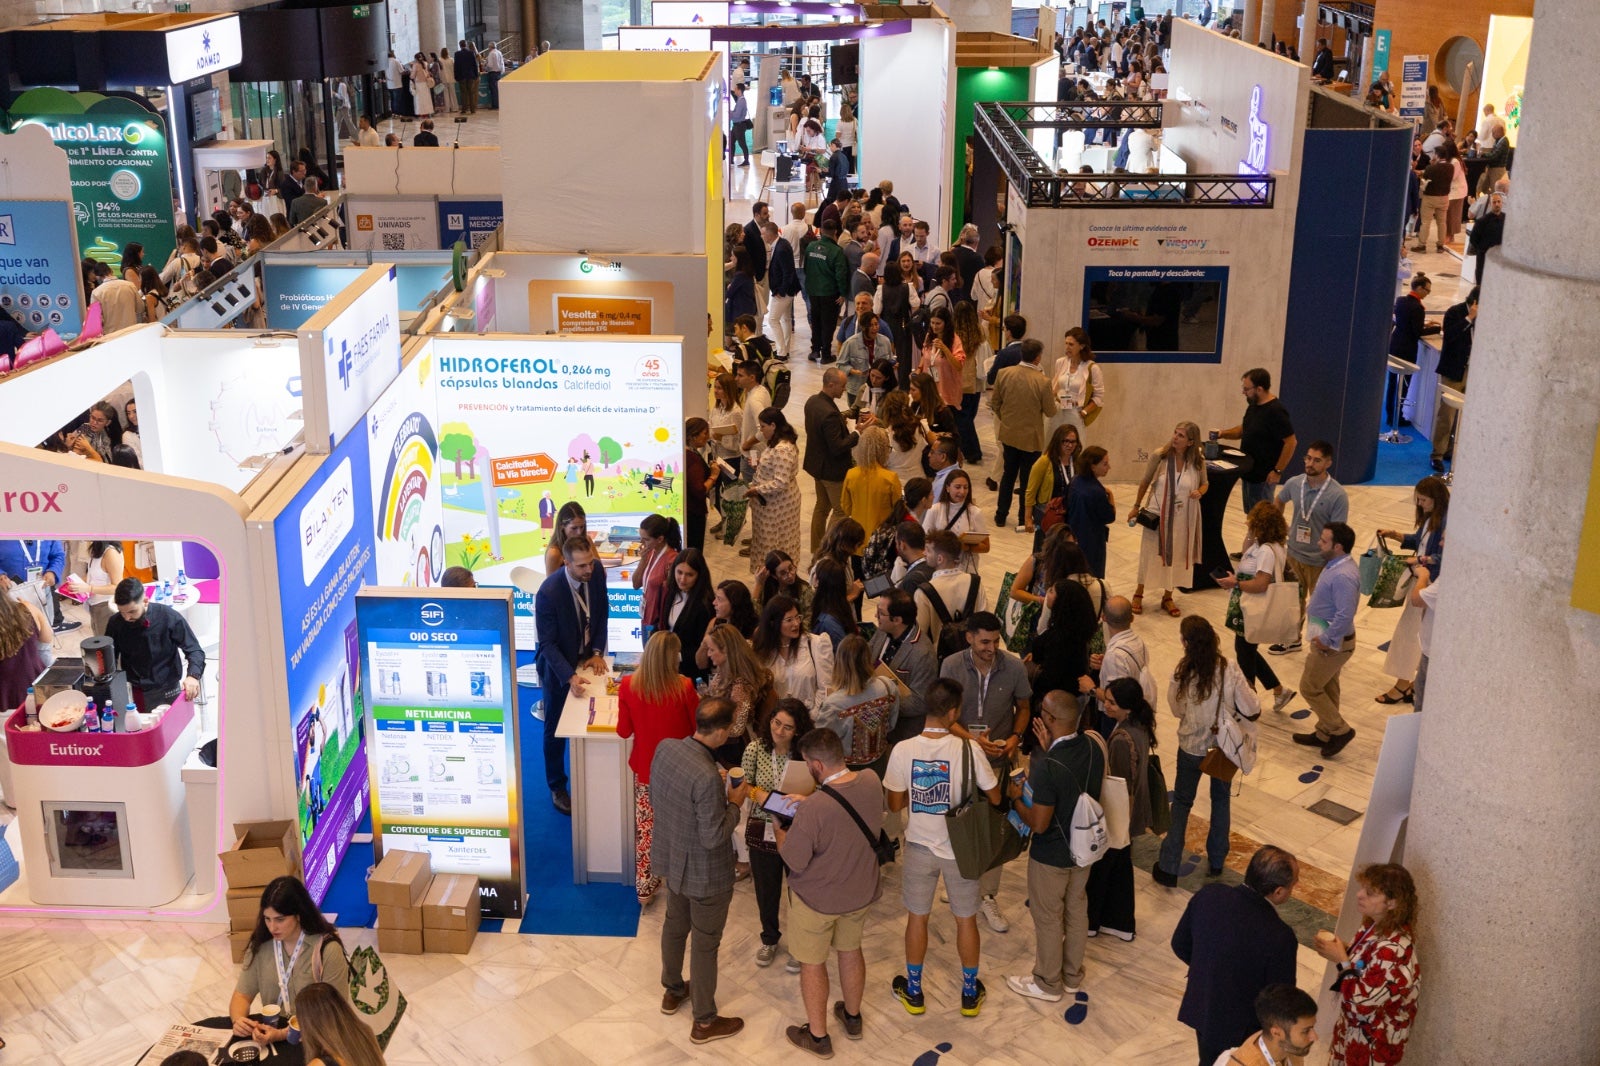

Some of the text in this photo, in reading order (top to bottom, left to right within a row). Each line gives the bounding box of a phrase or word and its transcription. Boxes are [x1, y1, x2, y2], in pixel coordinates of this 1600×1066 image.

[197, 52, 220, 70] ADAMED
[47, 122, 123, 141] ulcoLax
[92, 146, 124, 155] LÍNEA
[96, 202, 120, 211] 94%
[0, 223, 8, 237] R
[1166, 239, 1207, 249] wegovy
[25, 259, 48, 267] van
[0, 273, 51, 284] cuidado
[1132, 270, 1160, 278] pantalla
[562, 310, 597, 319] Vesolta
[354, 334, 369, 362] FAES
[369, 314, 390, 348] FARMA
[440, 357, 611, 377] HIDROFEROL 0,266 mg
[440, 376, 612, 390] cápsulas blandas Calcifediol
[458, 402, 508, 411] PREVENCIÓN
[577, 405, 601, 413] déficit
[496, 458, 539, 470] Calcifediol,
[498, 471, 505, 479] la
[520, 467, 548, 478] Directa
[305, 484, 349, 546] BILAXTEN
[302, 608, 310, 634] ASÍ
[311, 602, 317, 620] ES
[318, 593, 324, 610] LA
[325, 572, 338, 600] GAMA
[290, 549, 371, 670] TAN VARIADA COMO SUS PACIENTES
[410, 632, 458, 642] OJO SECO
[405, 710, 471, 719] NETILMICINA
[911, 783, 950, 804] PATAGONIA
[391, 826, 438, 834] CORTICOIDE
[456, 828, 502, 836] SUPERFICIE
[479, 887, 498, 897] MA
[171, 1024, 204, 1034] IDEAL
